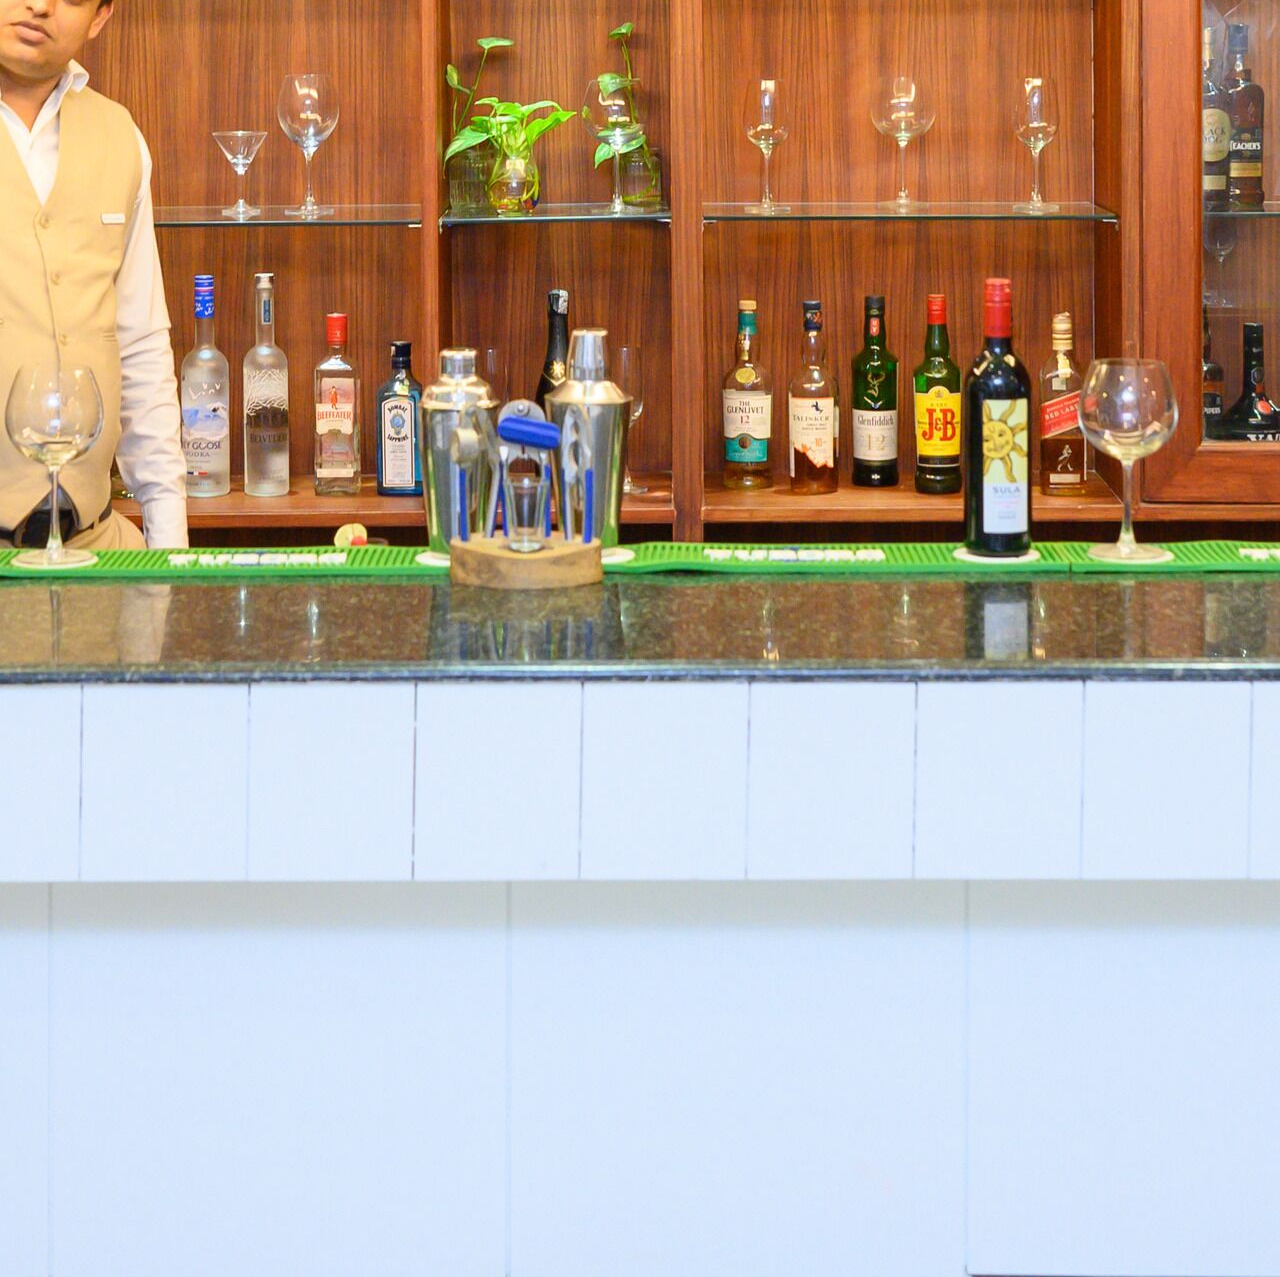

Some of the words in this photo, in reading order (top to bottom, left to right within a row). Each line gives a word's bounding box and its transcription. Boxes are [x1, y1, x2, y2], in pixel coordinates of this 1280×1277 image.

[387, 404, 408, 413] BOMBAY
[726, 405, 765, 415] GLENLIVET
[317, 410, 352, 421] BEEFEATER
[739, 415, 751, 425] 12
[792, 414, 830, 423] TALISKER
[1044, 409, 1060, 421] RED
[856, 414, 894, 427] Glenfiddich
[921, 407, 957, 442] J&B
[387, 433, 409, 443] SAPPHIRE
[865, 433, 886, 452] 12
[192, 440, 222, 450] GOOSE
[992, 486, 1021, 494] SULA
